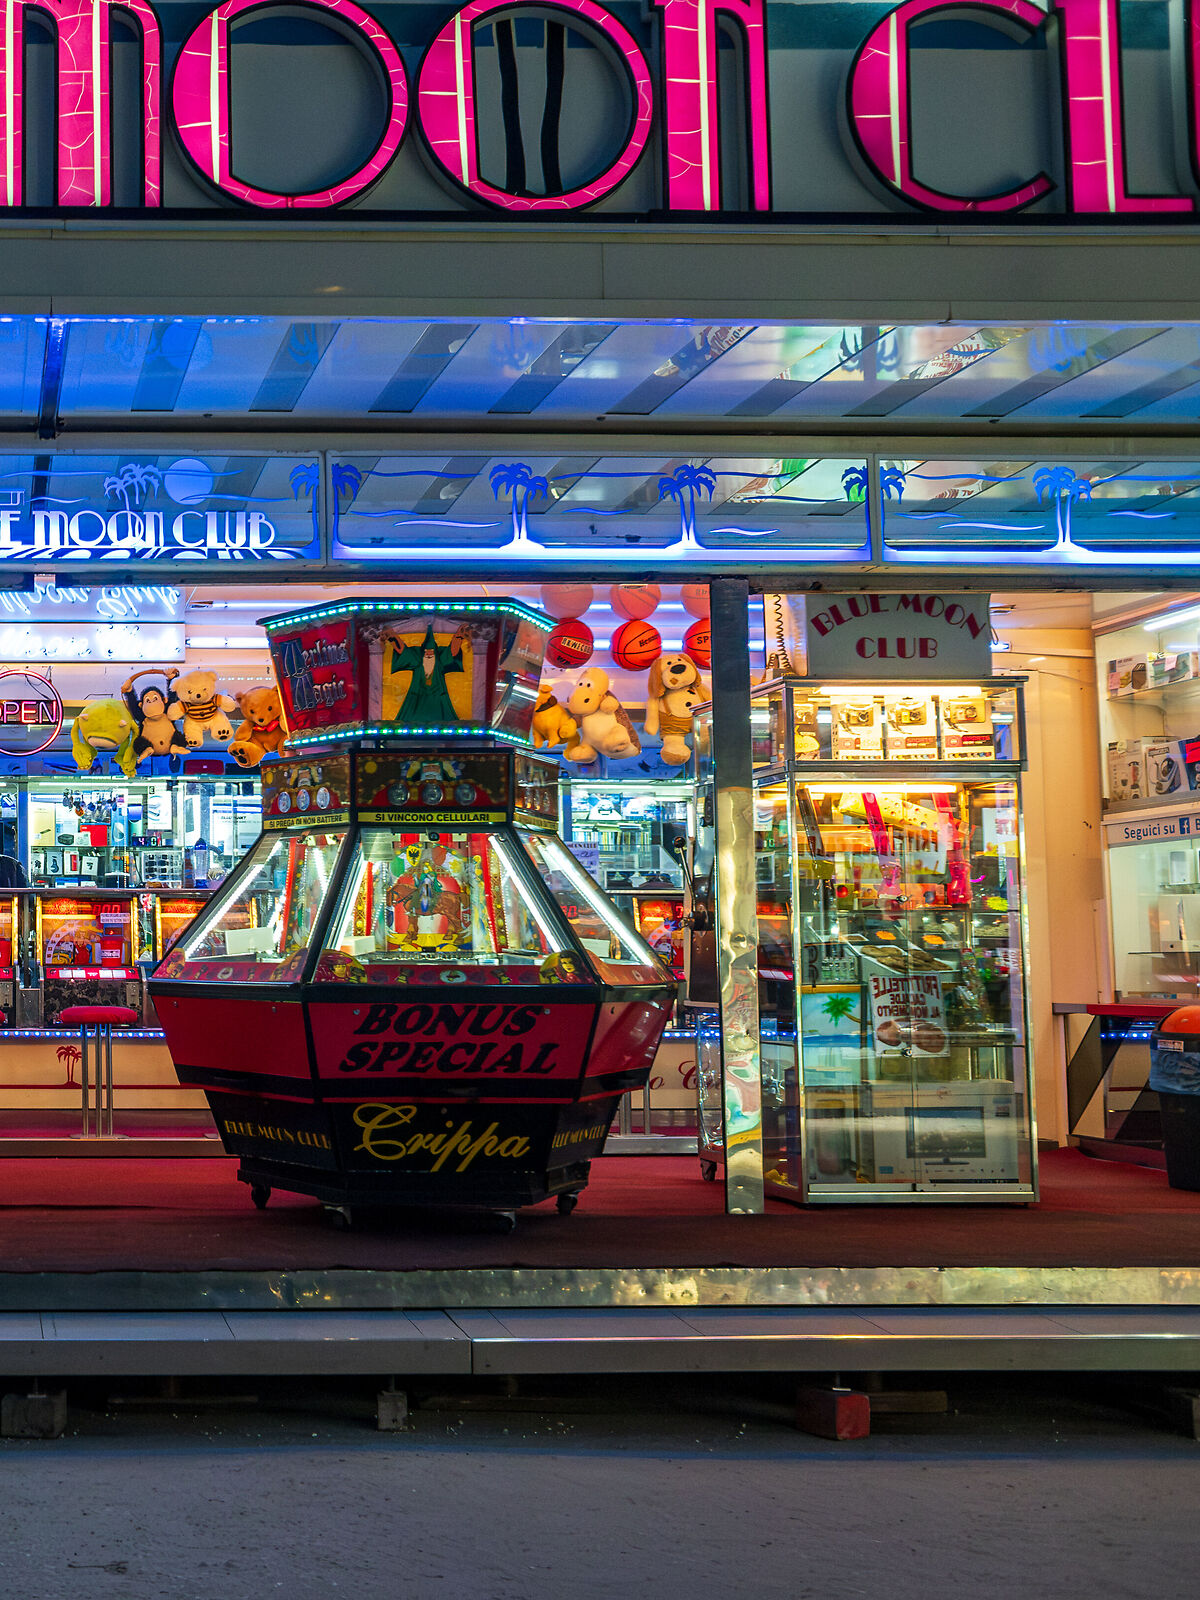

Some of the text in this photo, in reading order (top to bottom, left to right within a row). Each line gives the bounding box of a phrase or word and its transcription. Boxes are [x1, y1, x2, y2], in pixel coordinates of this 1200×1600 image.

[847, 0, 1200, 215] CL
[32, 509, 164, 549] MOON
[172, 510, 276, 549] CLUB
[810, 593, 987, 640] BLUE MOON
[855, 637, 939, 659] CLUB
[269, 814, 343, 828] SI PREGA DI NON BATTERE
[375, 813, 490, 822] SI VINCONO CELLULARI
[1123, 823, 1161, 841] Seguici
[1163, 823, 1176, 835] su
[353, 1004, 542, 1037] BONUS
[338, 1041, 560, 1076] SPECIAL
[352, 1102, 531, 1173] Crippa
